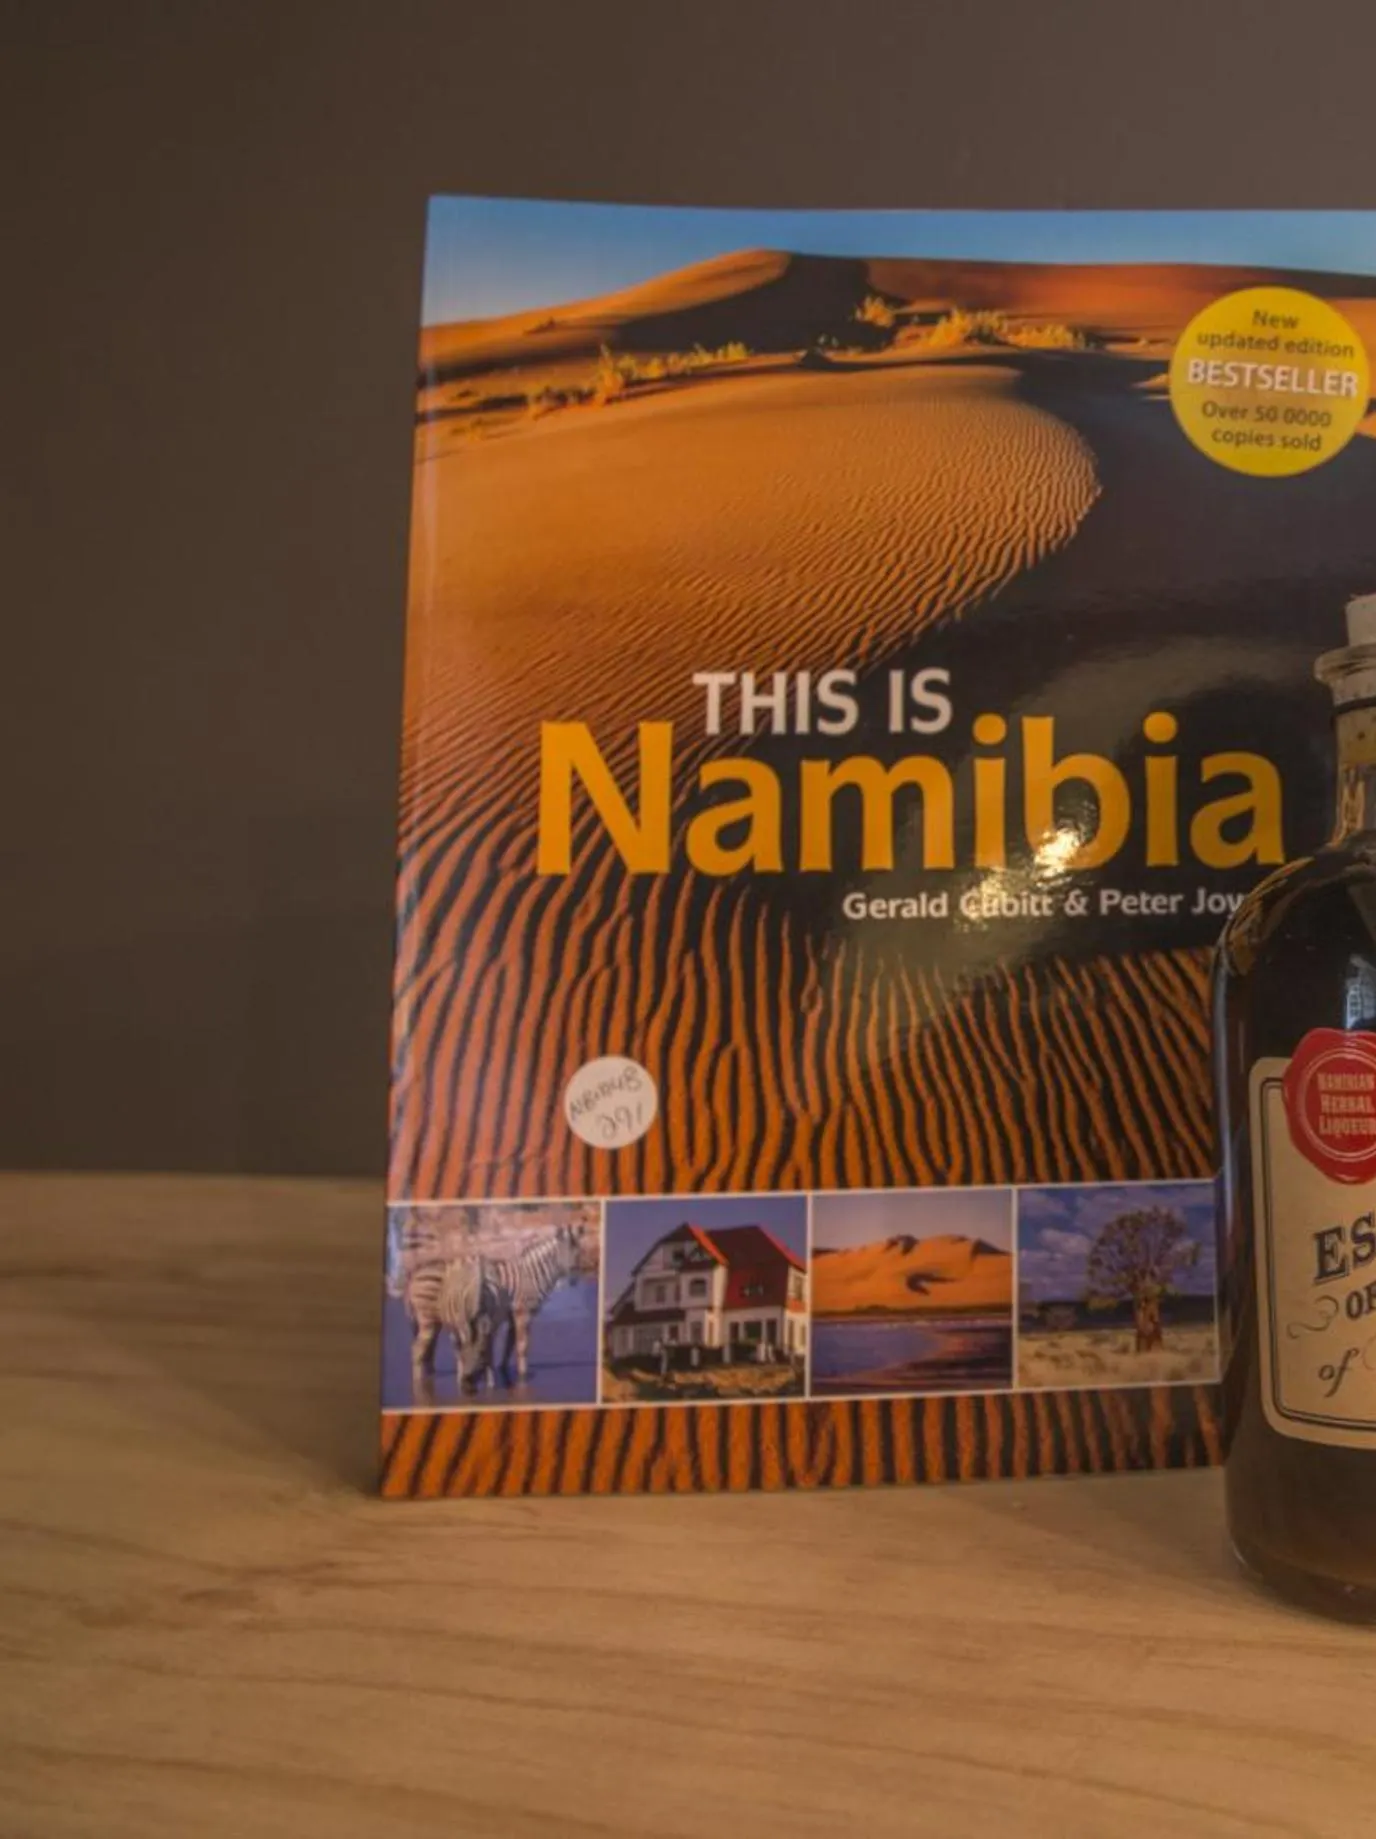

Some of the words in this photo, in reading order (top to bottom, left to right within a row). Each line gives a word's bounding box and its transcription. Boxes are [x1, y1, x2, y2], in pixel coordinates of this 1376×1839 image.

[1252, 309, 1299, 330] New
[1197, 331, 1280, 352] updated
[1285, 337, 1355, 357] edition
[1187, 357, 1359, 397] BESTSELLER
[1202, 400, 1248, 419] Over
[1255, 404, 1278, 424] 50
[1211, 428, 1275, 449] copies
[1281, 433, 1322, 452] sold
[693, 670, 858, 736] THIS
[889, 669, 954, 734] IS
[535, 711, 1287, 876] Namibia
[842, 892, 949, 919] Gerald
[958, 889, 1054, 918] Cubitt
[1063, 889, 1088, 916] &
[1099, 889, 1183, 916] Peter
[1318, 1347, 1358, 1398] of
